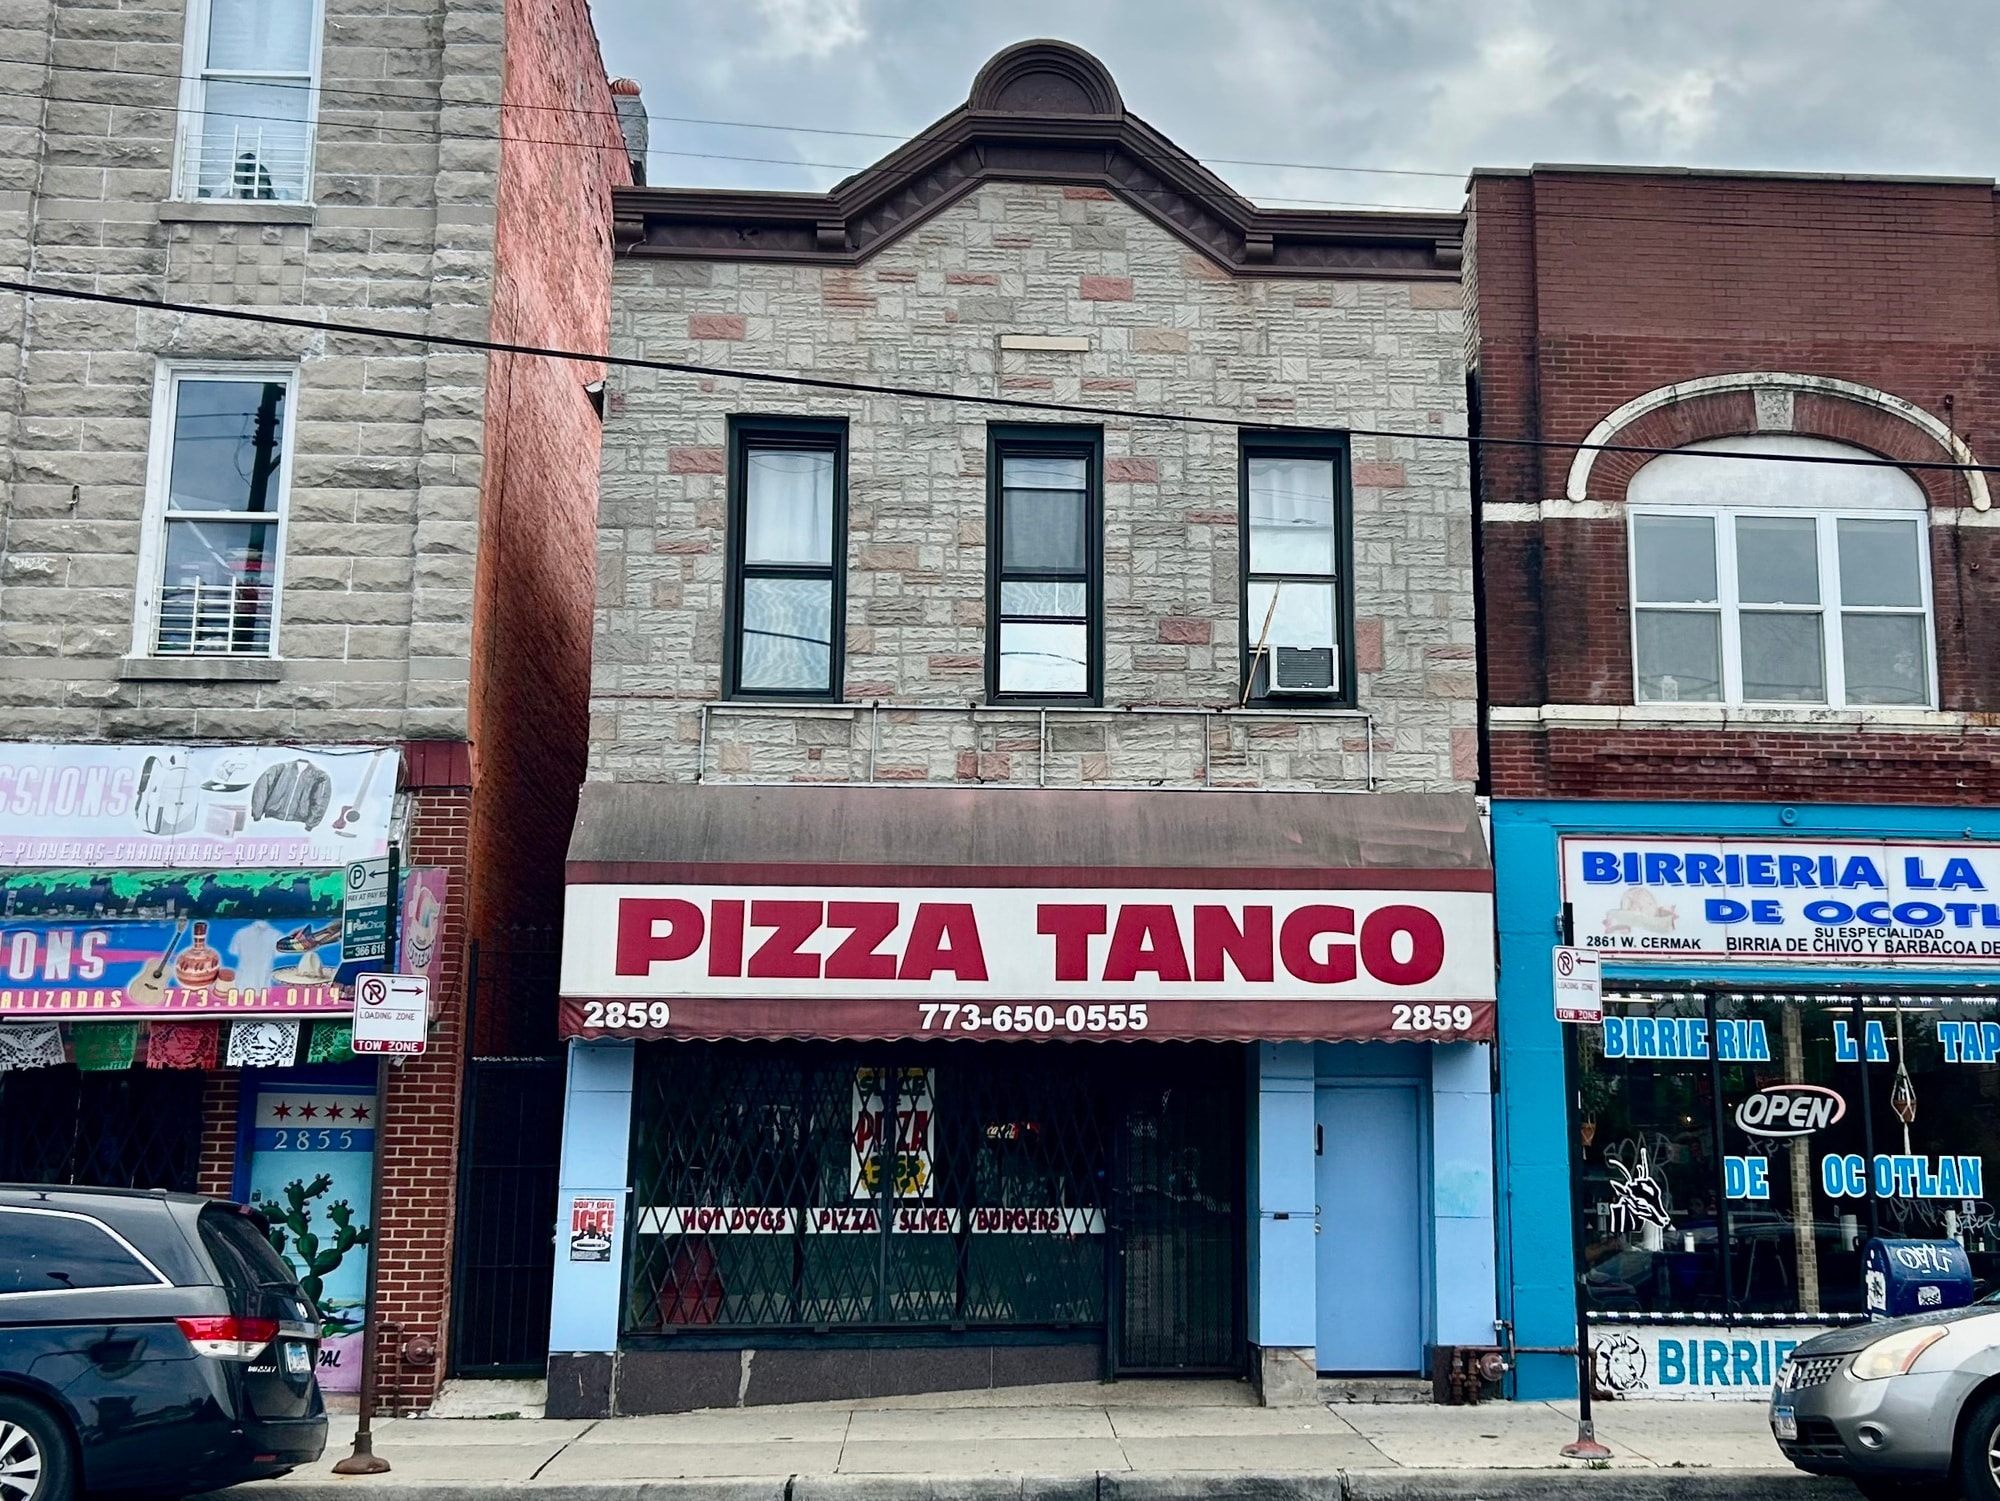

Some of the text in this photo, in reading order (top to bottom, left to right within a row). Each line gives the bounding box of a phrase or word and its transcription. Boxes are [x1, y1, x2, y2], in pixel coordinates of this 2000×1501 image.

[1582, 851, 1988, 892] BIRRIERIA LA
[1704, 898, 1784, 925] DE
[615, 897, 1445, 986] PIZZA TANGO
[1586, 935, 1701, 950] 2861 W. CERMAK
[1726, 936, 2000, 954] BIRRIA DE CHIVO Y BARBACOA DE
[1815, 927, 1944, 940] SU ESPECIALIDAD
[0, 931, 106, 980] ONS
[355, 946, 370, 957] 366
[359, 1011, 416, 1021] LOADING ZONE
[583, 1001, 1473, 1032] 2859 773-650-0555 2859
[1558, 1010, 1599, 1020] TOW ZONE
[357, 1040, 419, 1052] TOW ZONE
[1603, 1016, 1771, 1062] BIRRIERIA
[1833, 1020, 1890, 1063] LA
[1742, 1093, 1834, 1129] OPEN
[273, 1129, 353, 1151] 2855
[1724, 1155, 1770, 1199] DE
[1822, 1153, 1983, 1199] OCOTLAN
[572, 1210, 614, 1233] ICE!
[683, 1209, 1061, 1232] HOT DOGS PIZZA SLICE BURGERS
